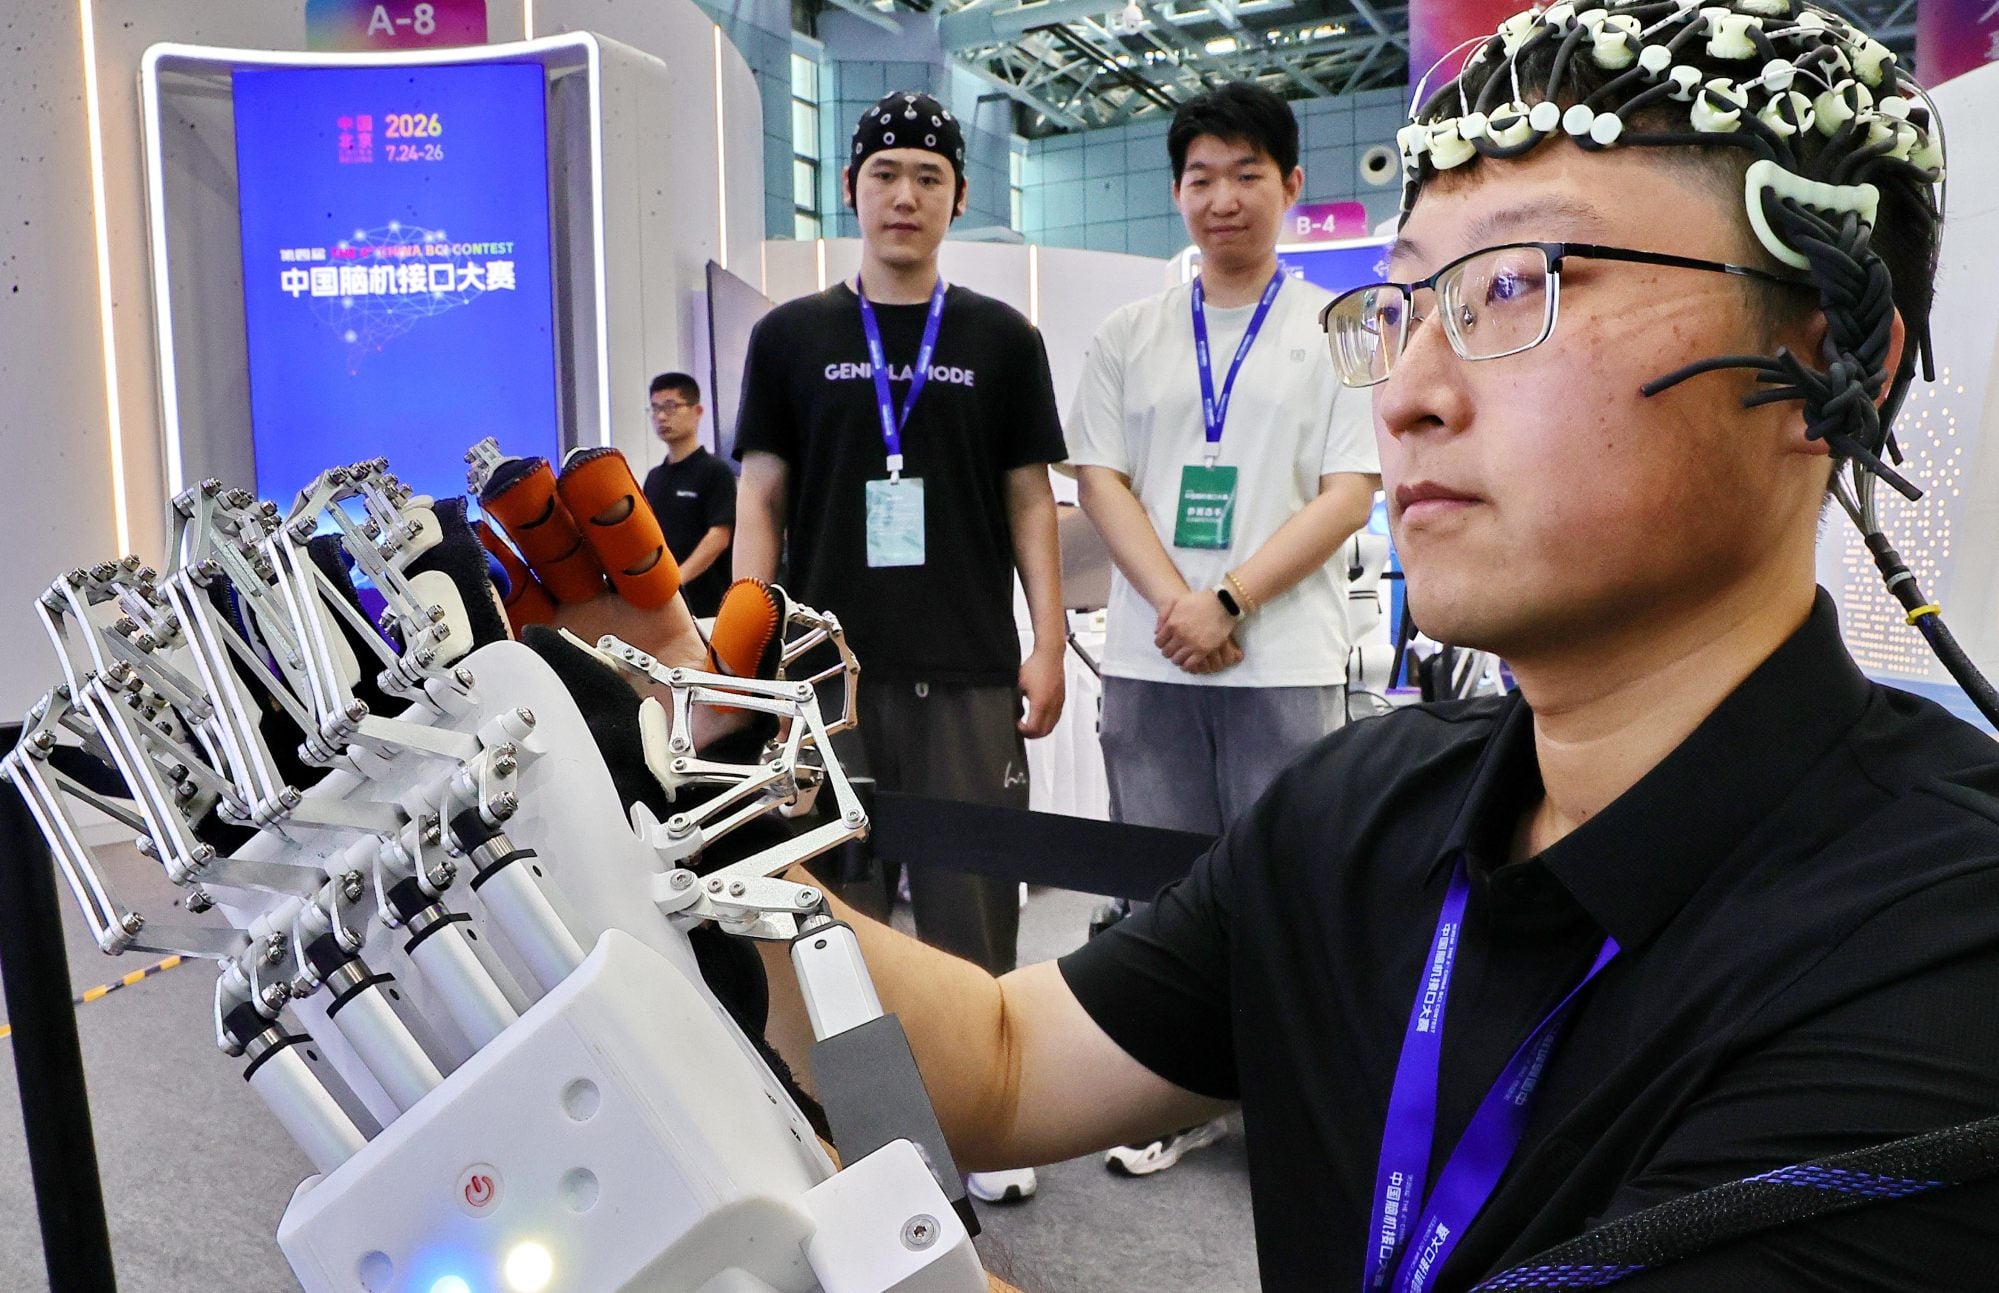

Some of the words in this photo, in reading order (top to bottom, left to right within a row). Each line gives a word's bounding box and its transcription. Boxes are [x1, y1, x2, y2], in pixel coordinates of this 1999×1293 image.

[368, 3, 436, 36] A-8
[385, 113, 442, 138] 2026
[385, 144, 444, 162] 7.24-26
[1296, 214, 1336, 236] B-4
[452, 242, 514, 256] CONTEST
[280, 260, 516, 298] 中国脑机接口大赛
[1416, 923, 1451, 1033] 中国脑机接口大赛
